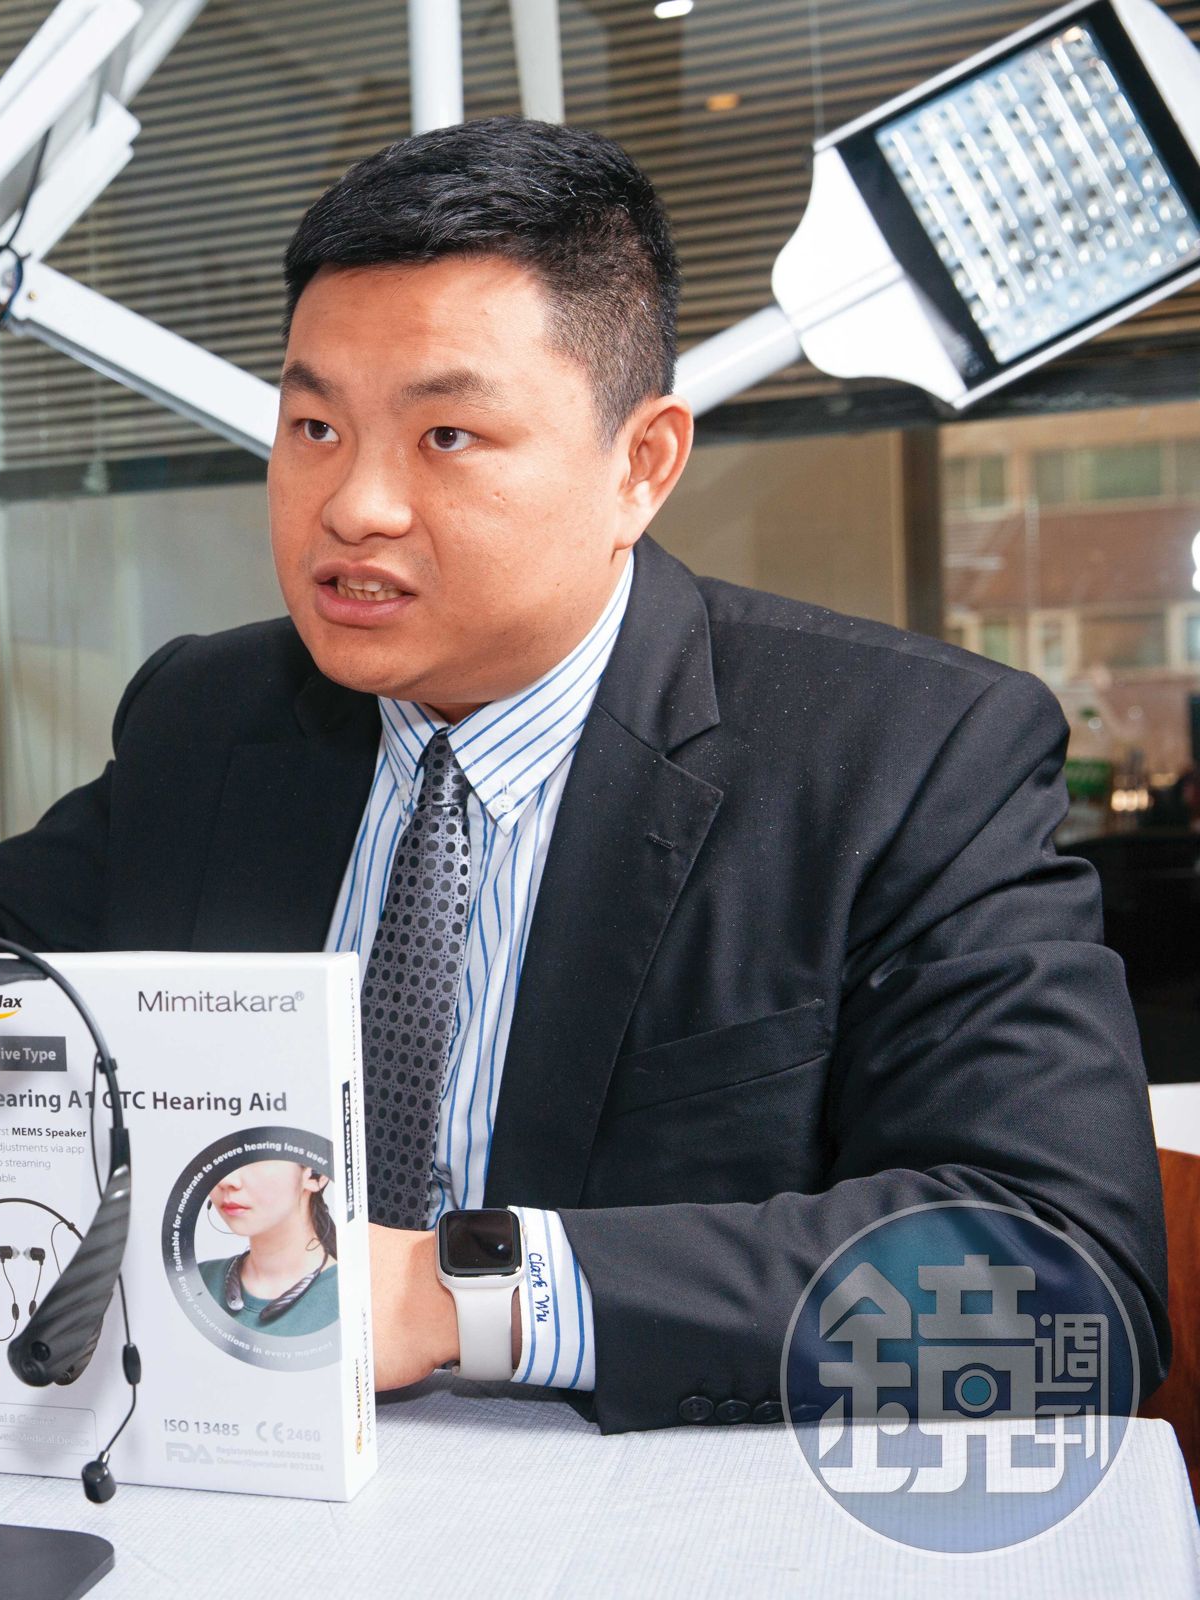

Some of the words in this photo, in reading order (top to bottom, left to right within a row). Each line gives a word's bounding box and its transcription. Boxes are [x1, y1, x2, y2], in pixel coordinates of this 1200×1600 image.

[23, 1048, 56, 1063] Type
[68, 1090, 94, 1109] A1
[153, 1092, 241, 1116] Hearing
[249, 1092, 287, 1111] Aid
[12, 1127, 43, 1137] MEMS
[46, 1128, 86, 1139] Speaker
[50, 1144, 63, 1153] via
[66, 1146, 84, 1155] app
[244, 1141, 282, 1152] hearing
[284, 1142, 305, 1155] loss
[213, 1146, 243, 1165] severe
[306, 1150, 329, 1166] user
[5, 1159, 51, 1170] streaming
[203, 1161, 213, 1174] to
[177, 1173, 204, 1214] moderate
[173, 1213, 183, 1229] for
[529, 1252, 548, 1288] Clark
[164, 1419, 189, 1433] ISO
[194, 1421, 240, 1437] 13485
[288, 1429, 321, 1442] 2460
[165, 1442, 214, 1465] FDA
